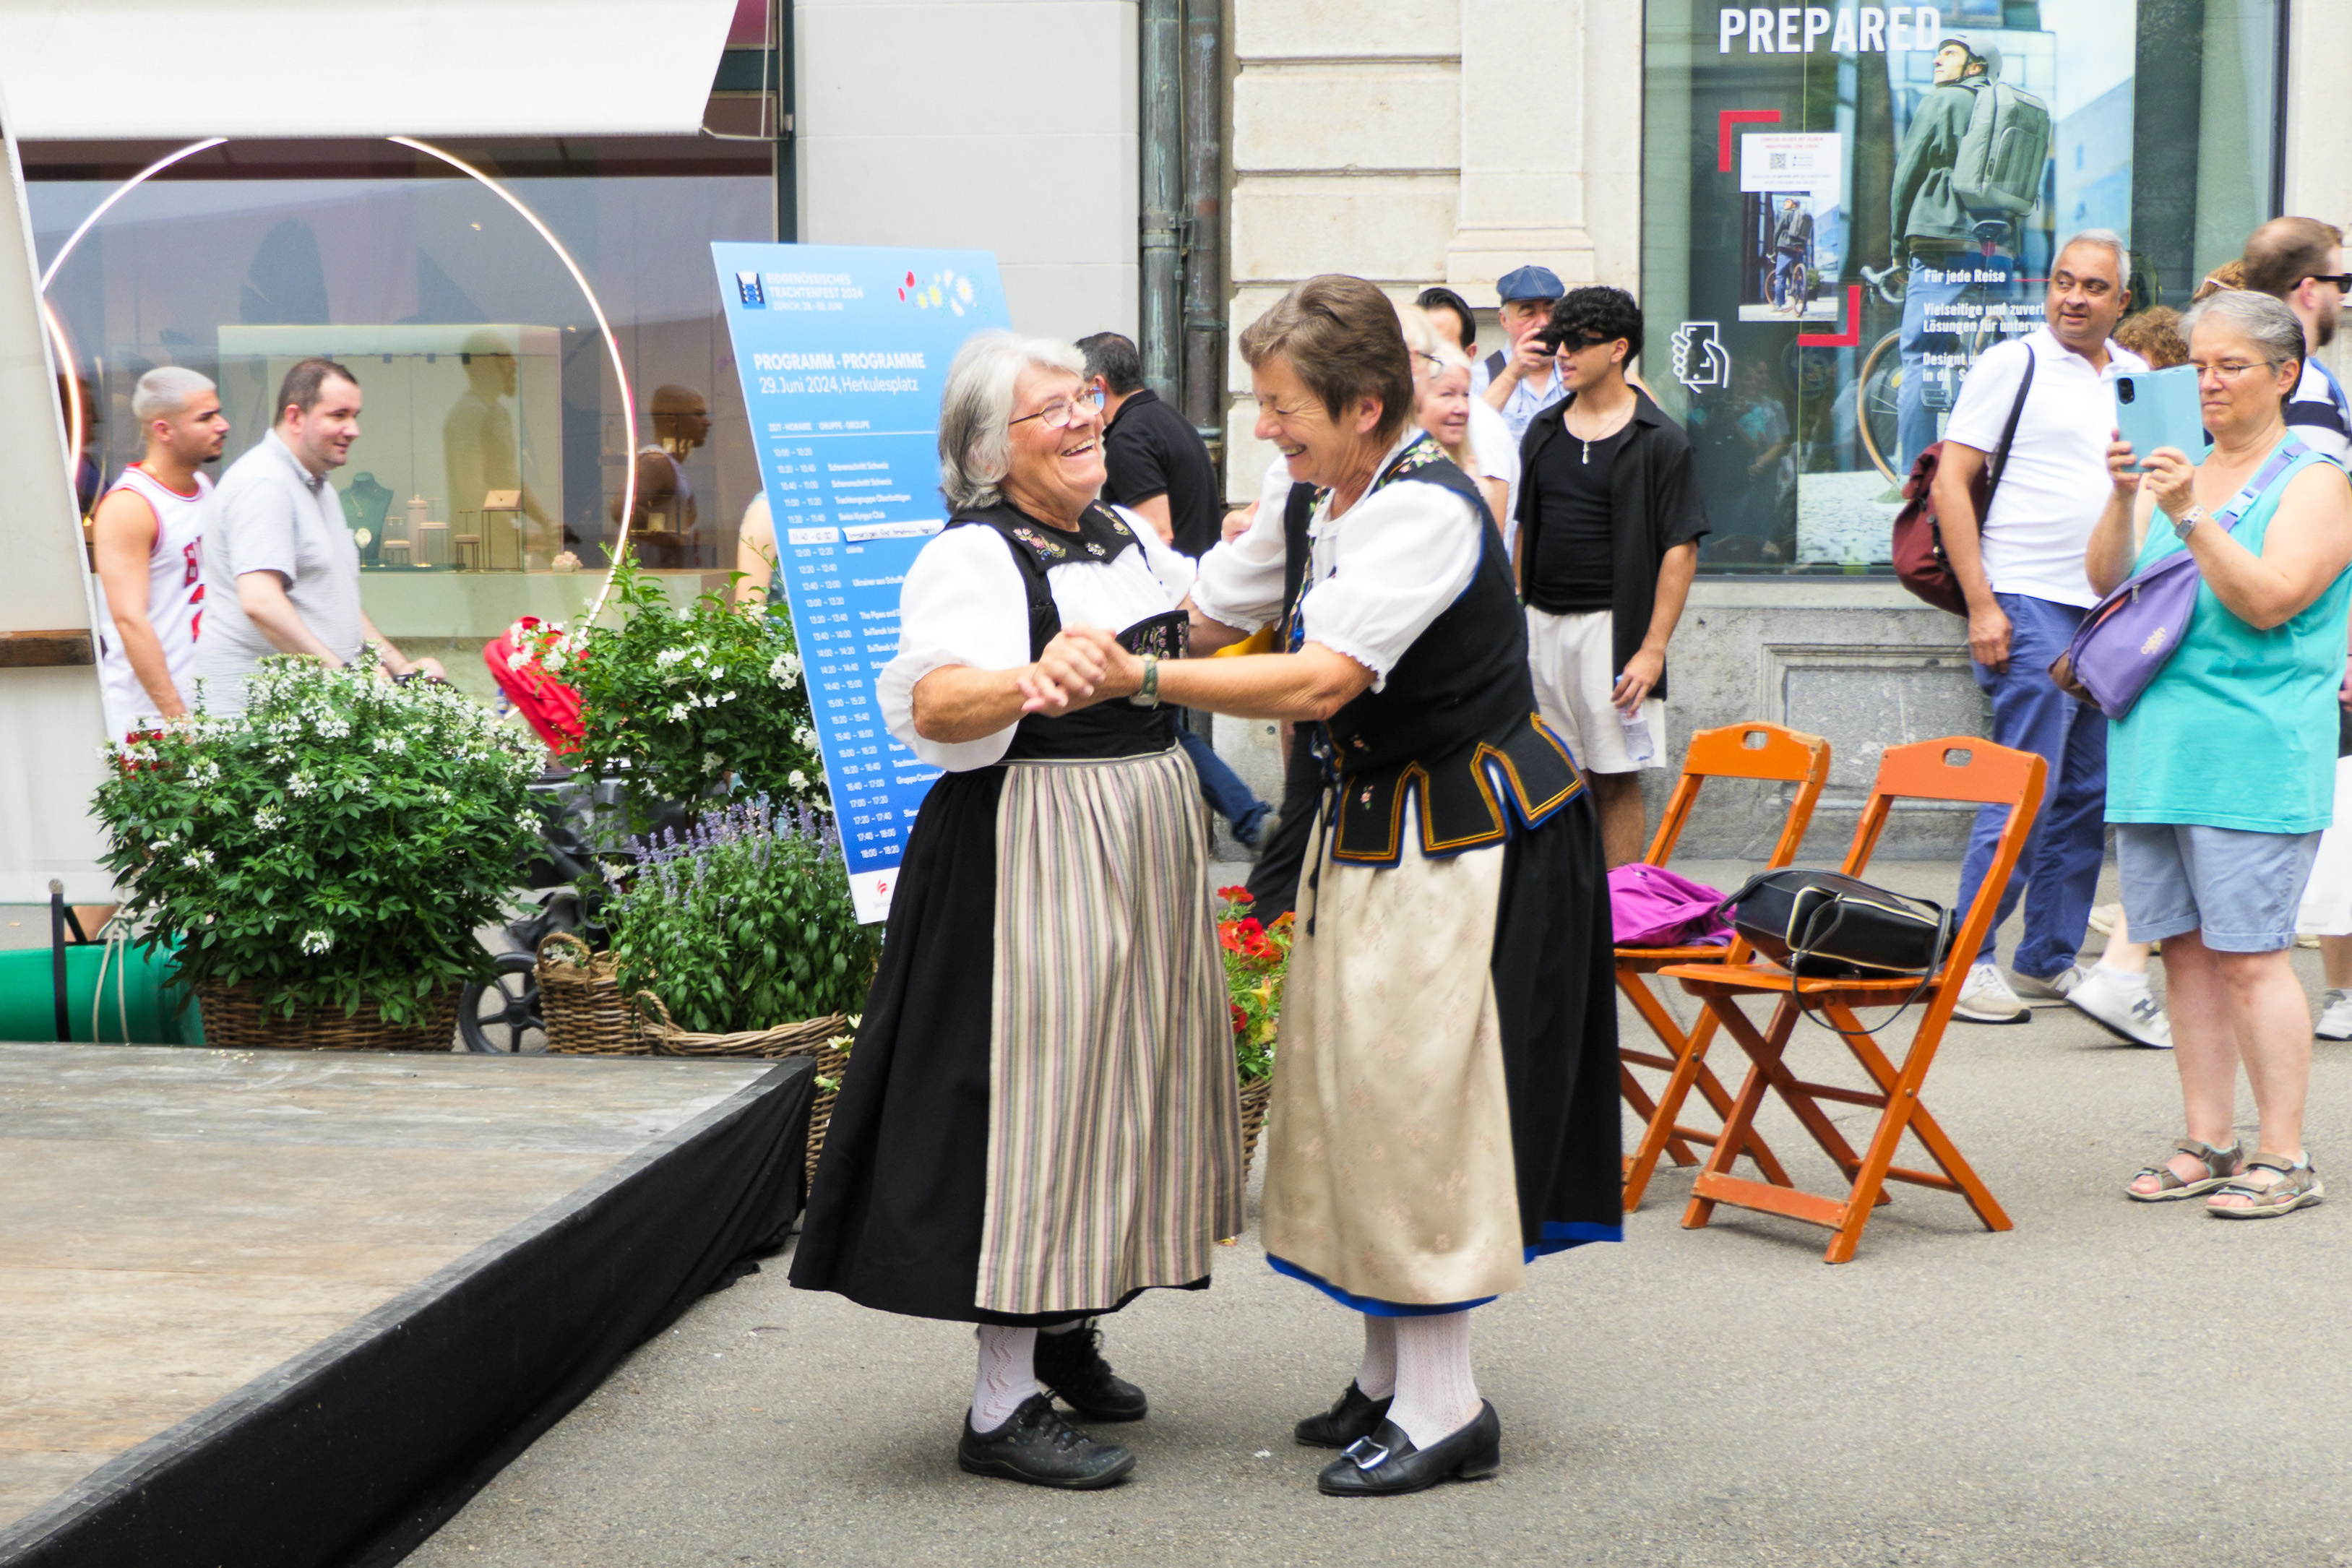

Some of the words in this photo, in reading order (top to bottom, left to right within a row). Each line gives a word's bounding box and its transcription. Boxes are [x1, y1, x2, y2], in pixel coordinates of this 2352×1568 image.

[1719, 7, 1941, 54] PREPARED
[1924, 269, 1944, 283] Für
[1945, 270, 1972, 285] jede
[1973, 269, 2007, 283] Reise
[769, 286, 839, 298] TRACHTENFEST
[841, 287, 864, 299] 2024
[1923, 302, 1983, 319] Vielseitige
[1985, 302, 2007, 316] und
[2009, 302, 2046, 316] zuverl
[1923, 319, 1977, 335] Lösungen
[1979, 320, 1999, 332] für
[753, 353, 837, 371] PROGRAMM
[841, 352, 926, 370] PROGRAMME
[1923, 352, 1967, 368] Designt
[1922, 369, 1934, 382] in
[779, 376, 805, 394] Juni
[806, 375, 842, 395] 2024,
[840, 376, 920, 395] Herkulesplatz
